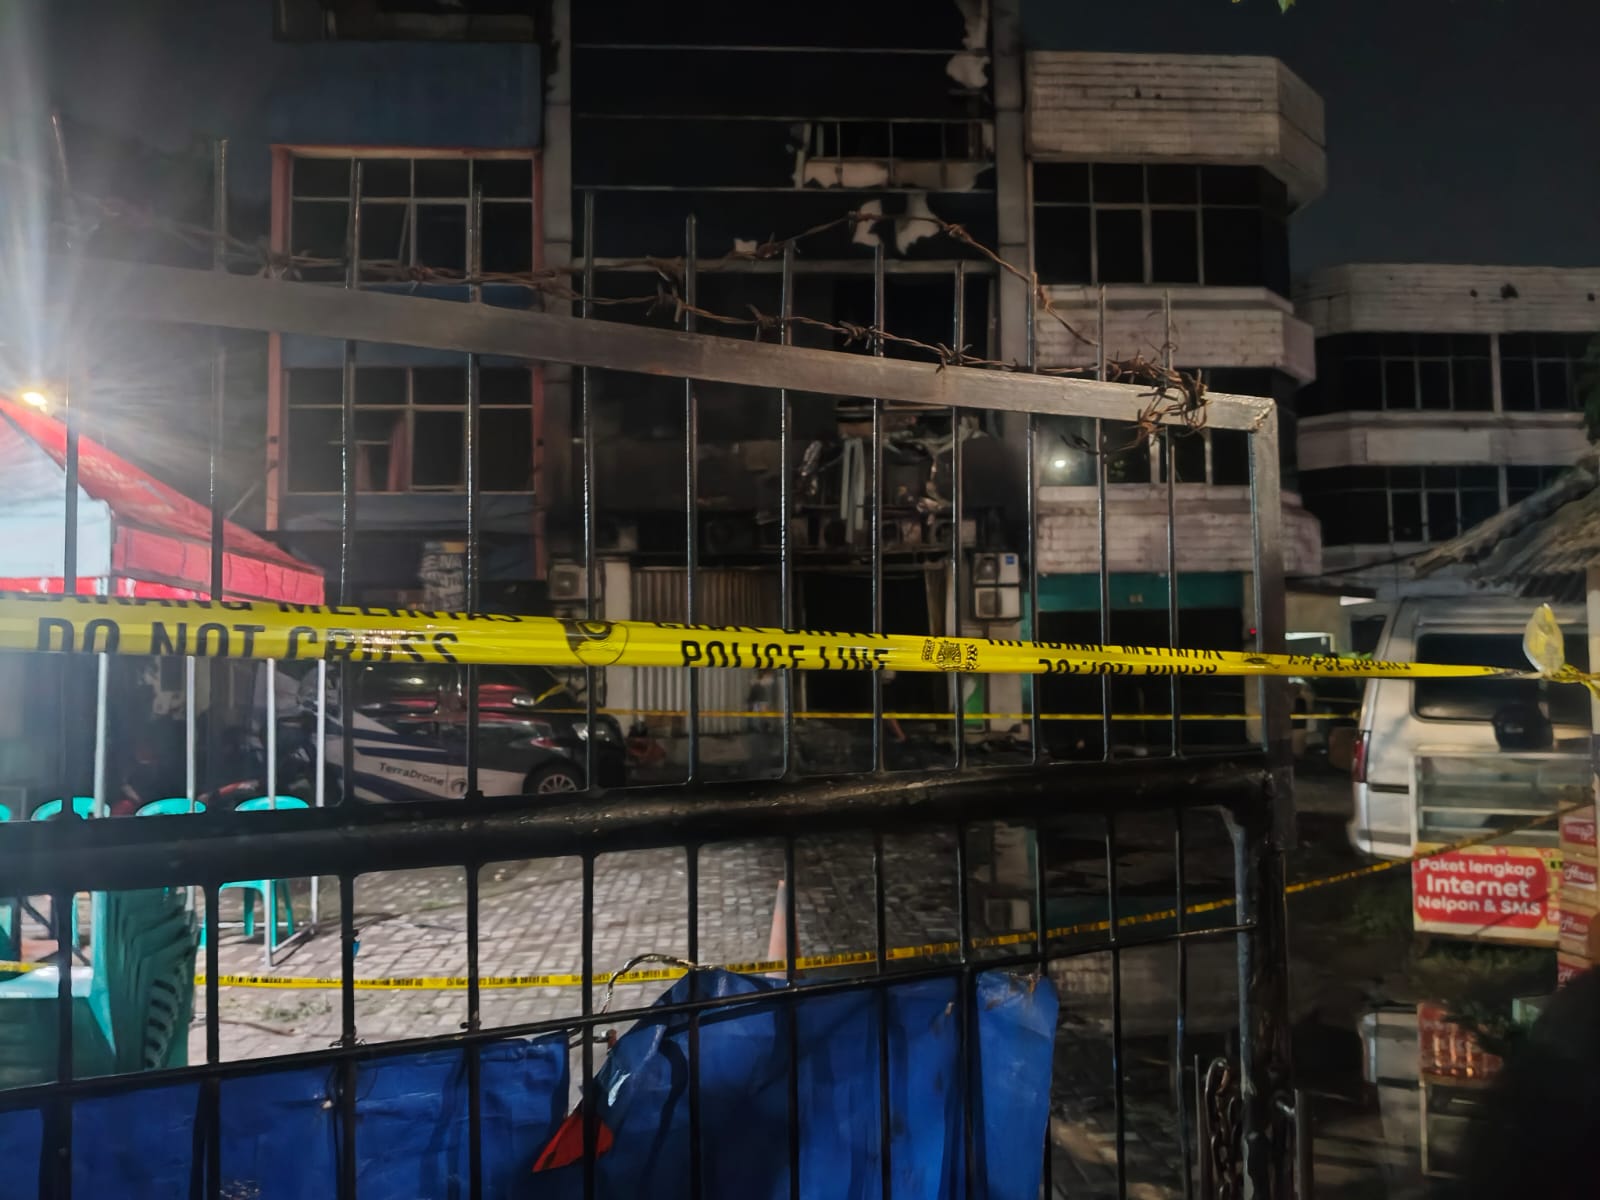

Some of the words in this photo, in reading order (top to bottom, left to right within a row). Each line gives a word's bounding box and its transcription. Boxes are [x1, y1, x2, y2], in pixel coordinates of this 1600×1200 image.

[38, 617, 120, 654] DO
[150, 621, 265, 657] NOT
[681, 640, 805, 668] POLICE
[380, 762, 444, 786] TerraDrone
[1419, 858, 1466, 873] Paket
[1469, 860, 1537, 878] lengkap
[1427, 873, 1530, 898] Internet
[1418, 895, 1480, 914] Nelpon
[1484, 899, 1497, 913] &
[1500, 900, 1541, 916] SMS
